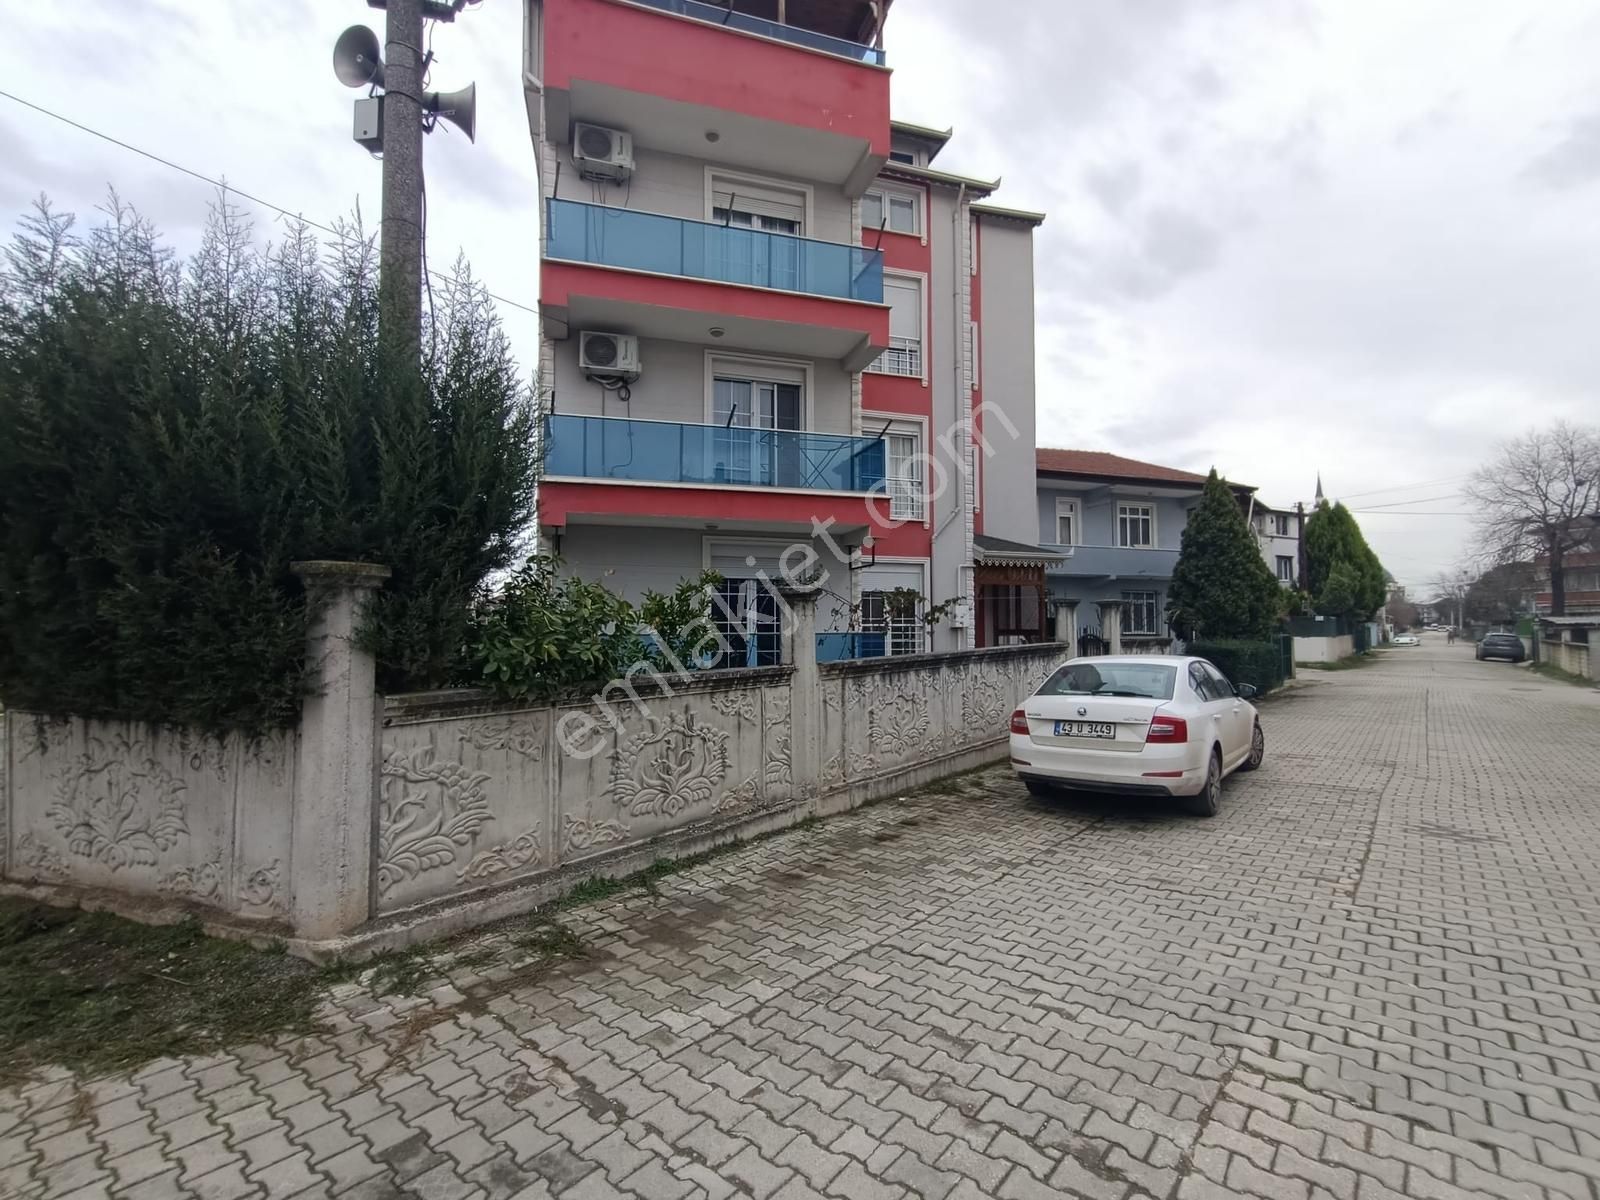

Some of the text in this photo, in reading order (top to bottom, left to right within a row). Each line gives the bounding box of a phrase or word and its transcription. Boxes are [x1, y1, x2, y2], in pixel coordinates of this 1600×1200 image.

[1061, 722, 1112, 735] 43 U 3449
